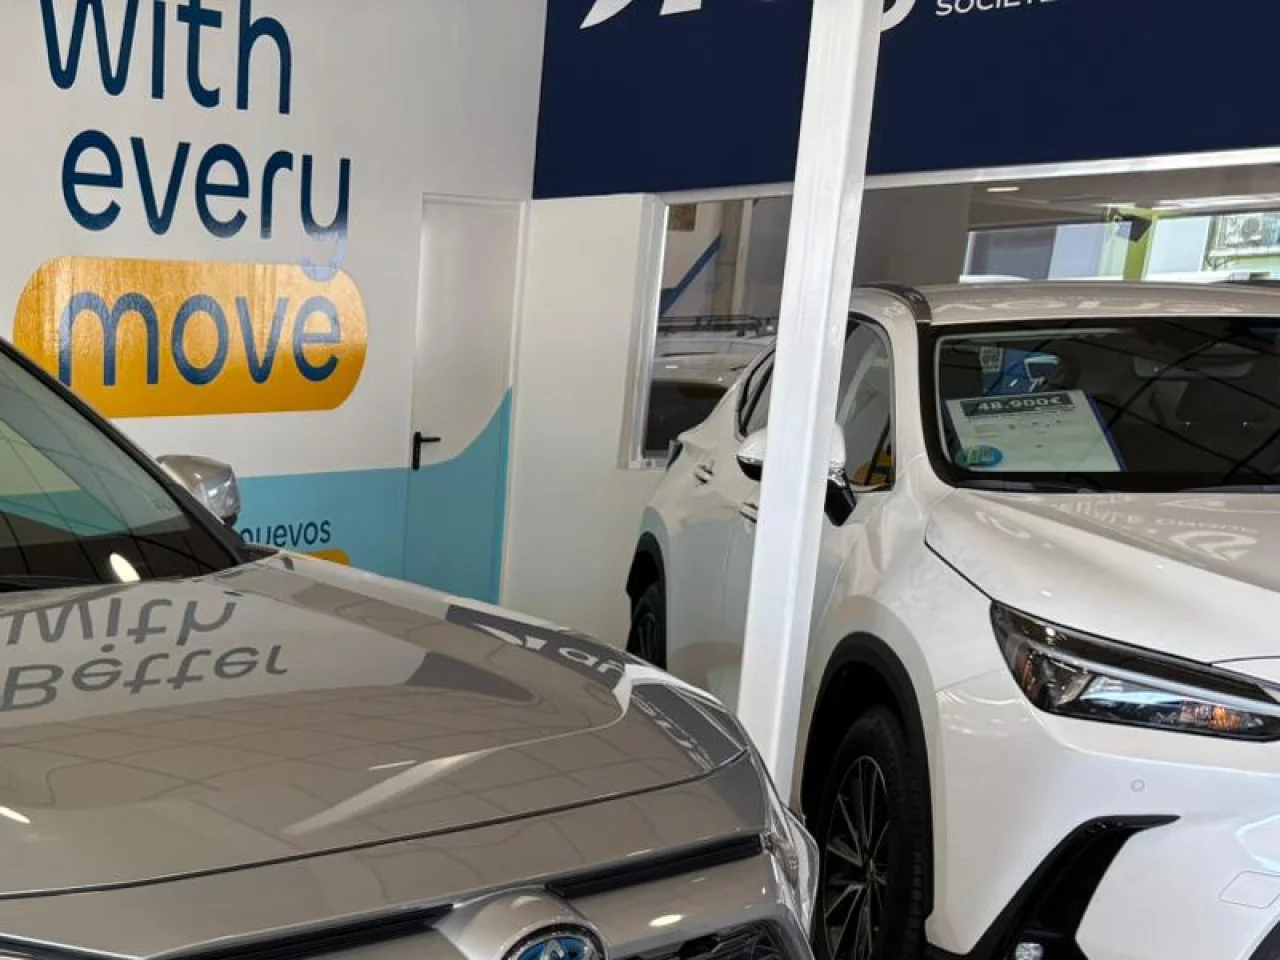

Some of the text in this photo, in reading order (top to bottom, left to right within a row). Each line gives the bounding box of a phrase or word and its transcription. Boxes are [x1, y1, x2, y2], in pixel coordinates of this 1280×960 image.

[61, 129, 351, 282] every
[58, 290, 342, 387] move
[240, 519, 332, 548] nuevos
